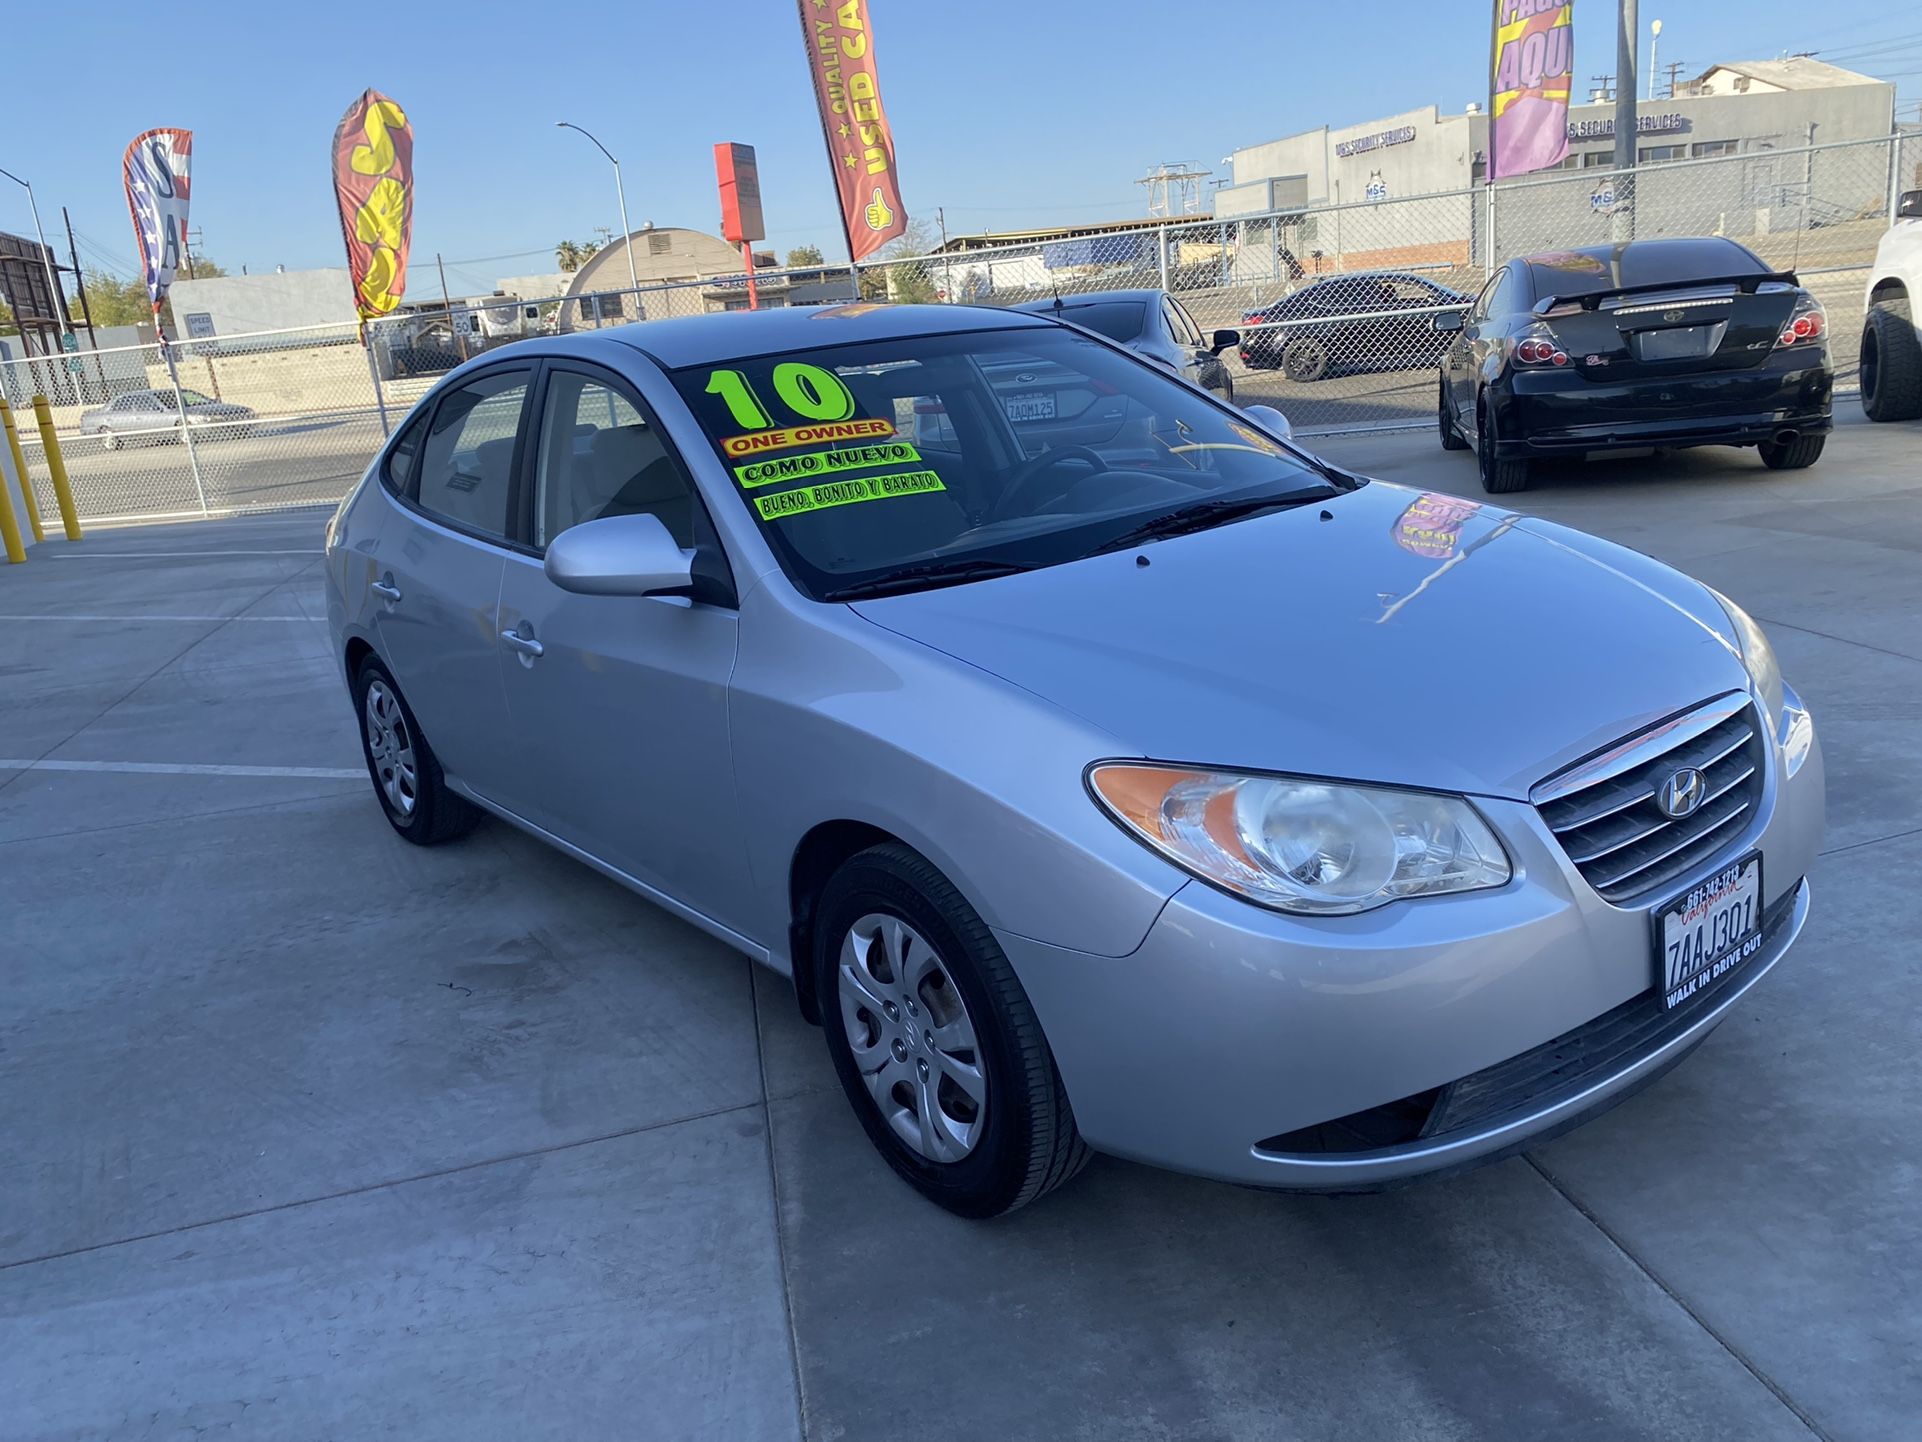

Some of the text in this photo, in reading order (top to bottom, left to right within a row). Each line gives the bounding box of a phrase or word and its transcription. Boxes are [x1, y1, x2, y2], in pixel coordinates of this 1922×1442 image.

[816, 19, 849, 115] QUALITY
[849, 71, 889, 176] USED
[456, 321, 469, 333] 50
[705, 362, 855, 430] 10
[731, 421, 888, 452] ONE OWNER
[743, 445, 912, 482] COMO NUEVO
[814, 482, 867, 504] BONITO
[868, 479, 881, 494] Y
[883, 473, 938, 492] BARATO
[1666, 933, 1762, 1009] WALK IN DRIVE OUT
[1668, 894, 1752, 988] 7AAJ301
